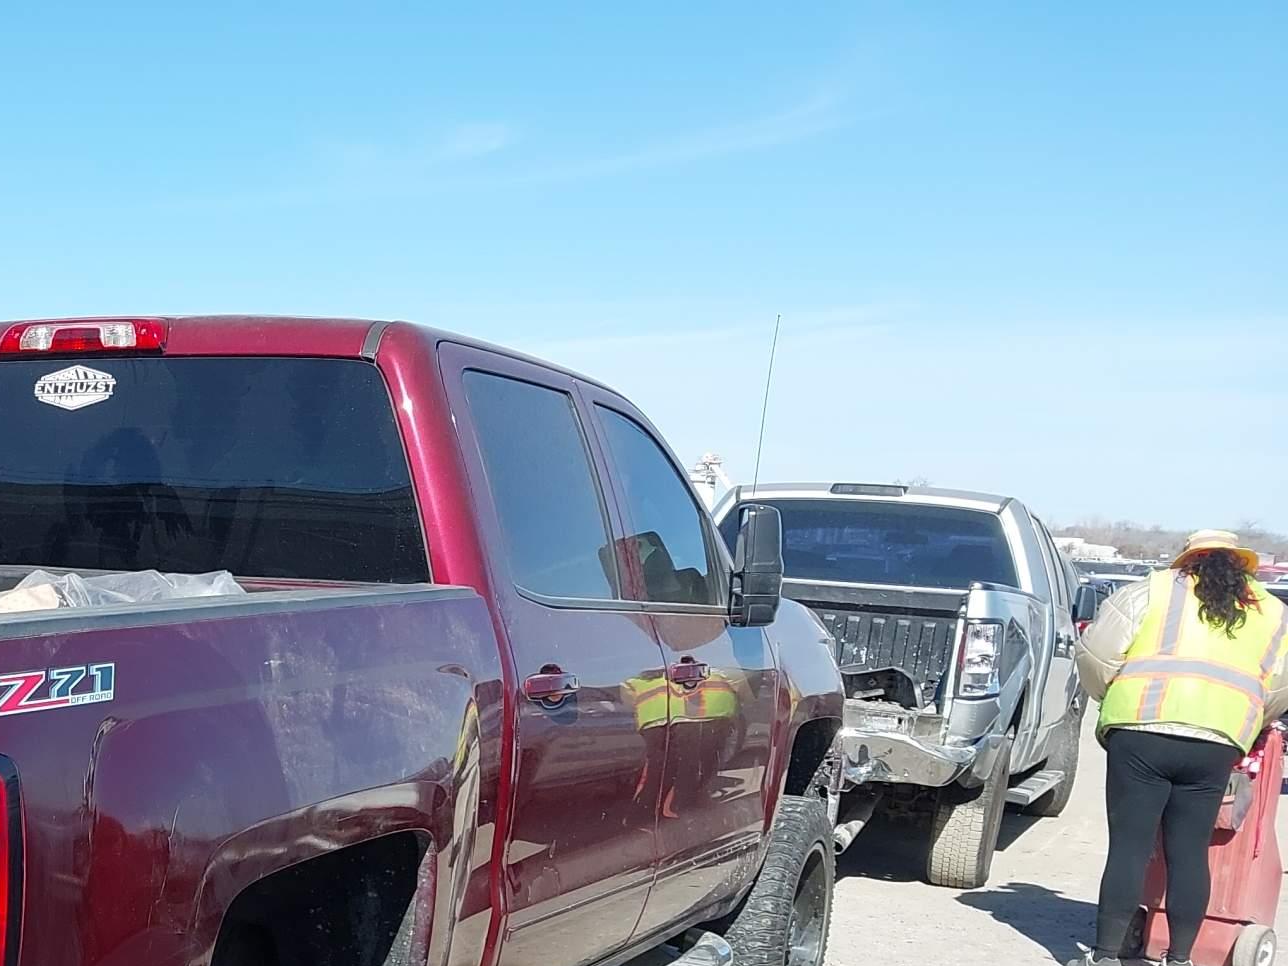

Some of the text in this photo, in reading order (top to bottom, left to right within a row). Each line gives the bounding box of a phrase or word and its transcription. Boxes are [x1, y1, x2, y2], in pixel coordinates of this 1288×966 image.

[34, 381, 116, 396] ENTHUZST
[71, 692, 112, 703] OFF ROAD
